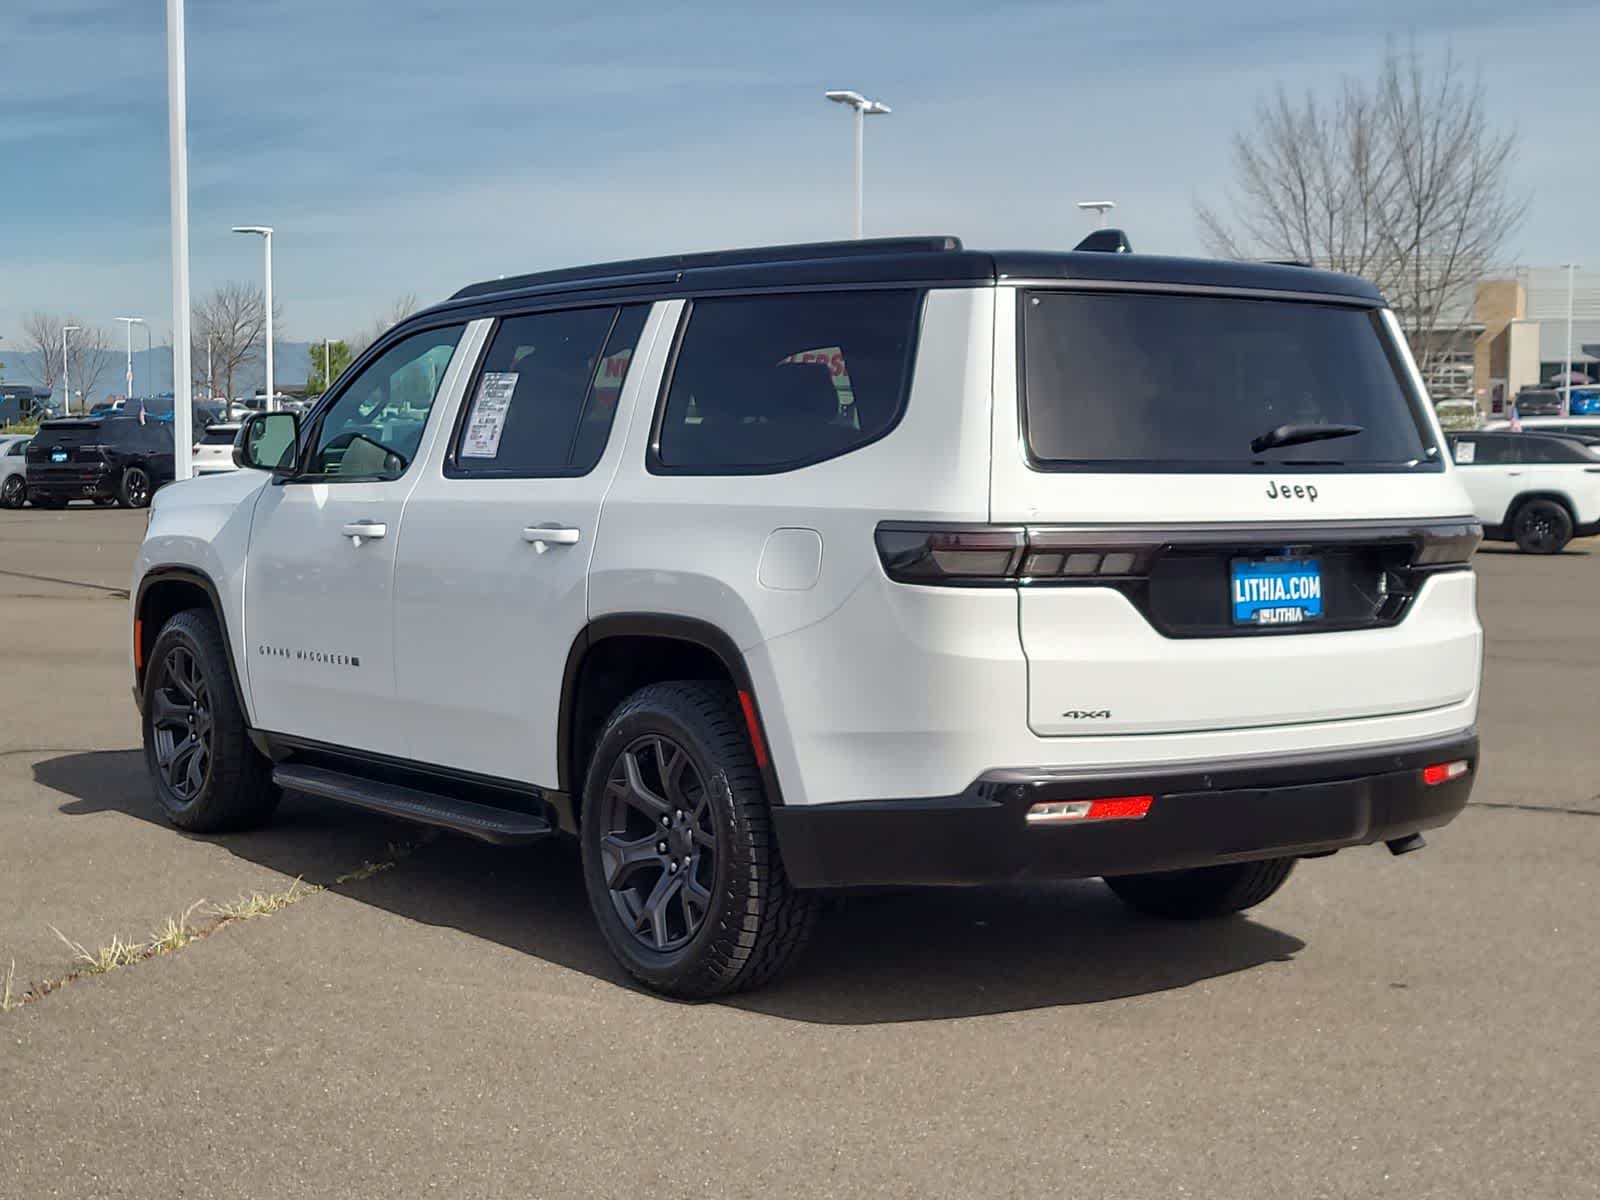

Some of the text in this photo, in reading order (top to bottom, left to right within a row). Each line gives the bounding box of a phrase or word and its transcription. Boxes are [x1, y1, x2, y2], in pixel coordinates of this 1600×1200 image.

[1266, 481, 1319, 503] Jeep
[1235, 575, 1321, 602] LITHIA.COM
[1274, 607, 1303, 623] LITHIA
